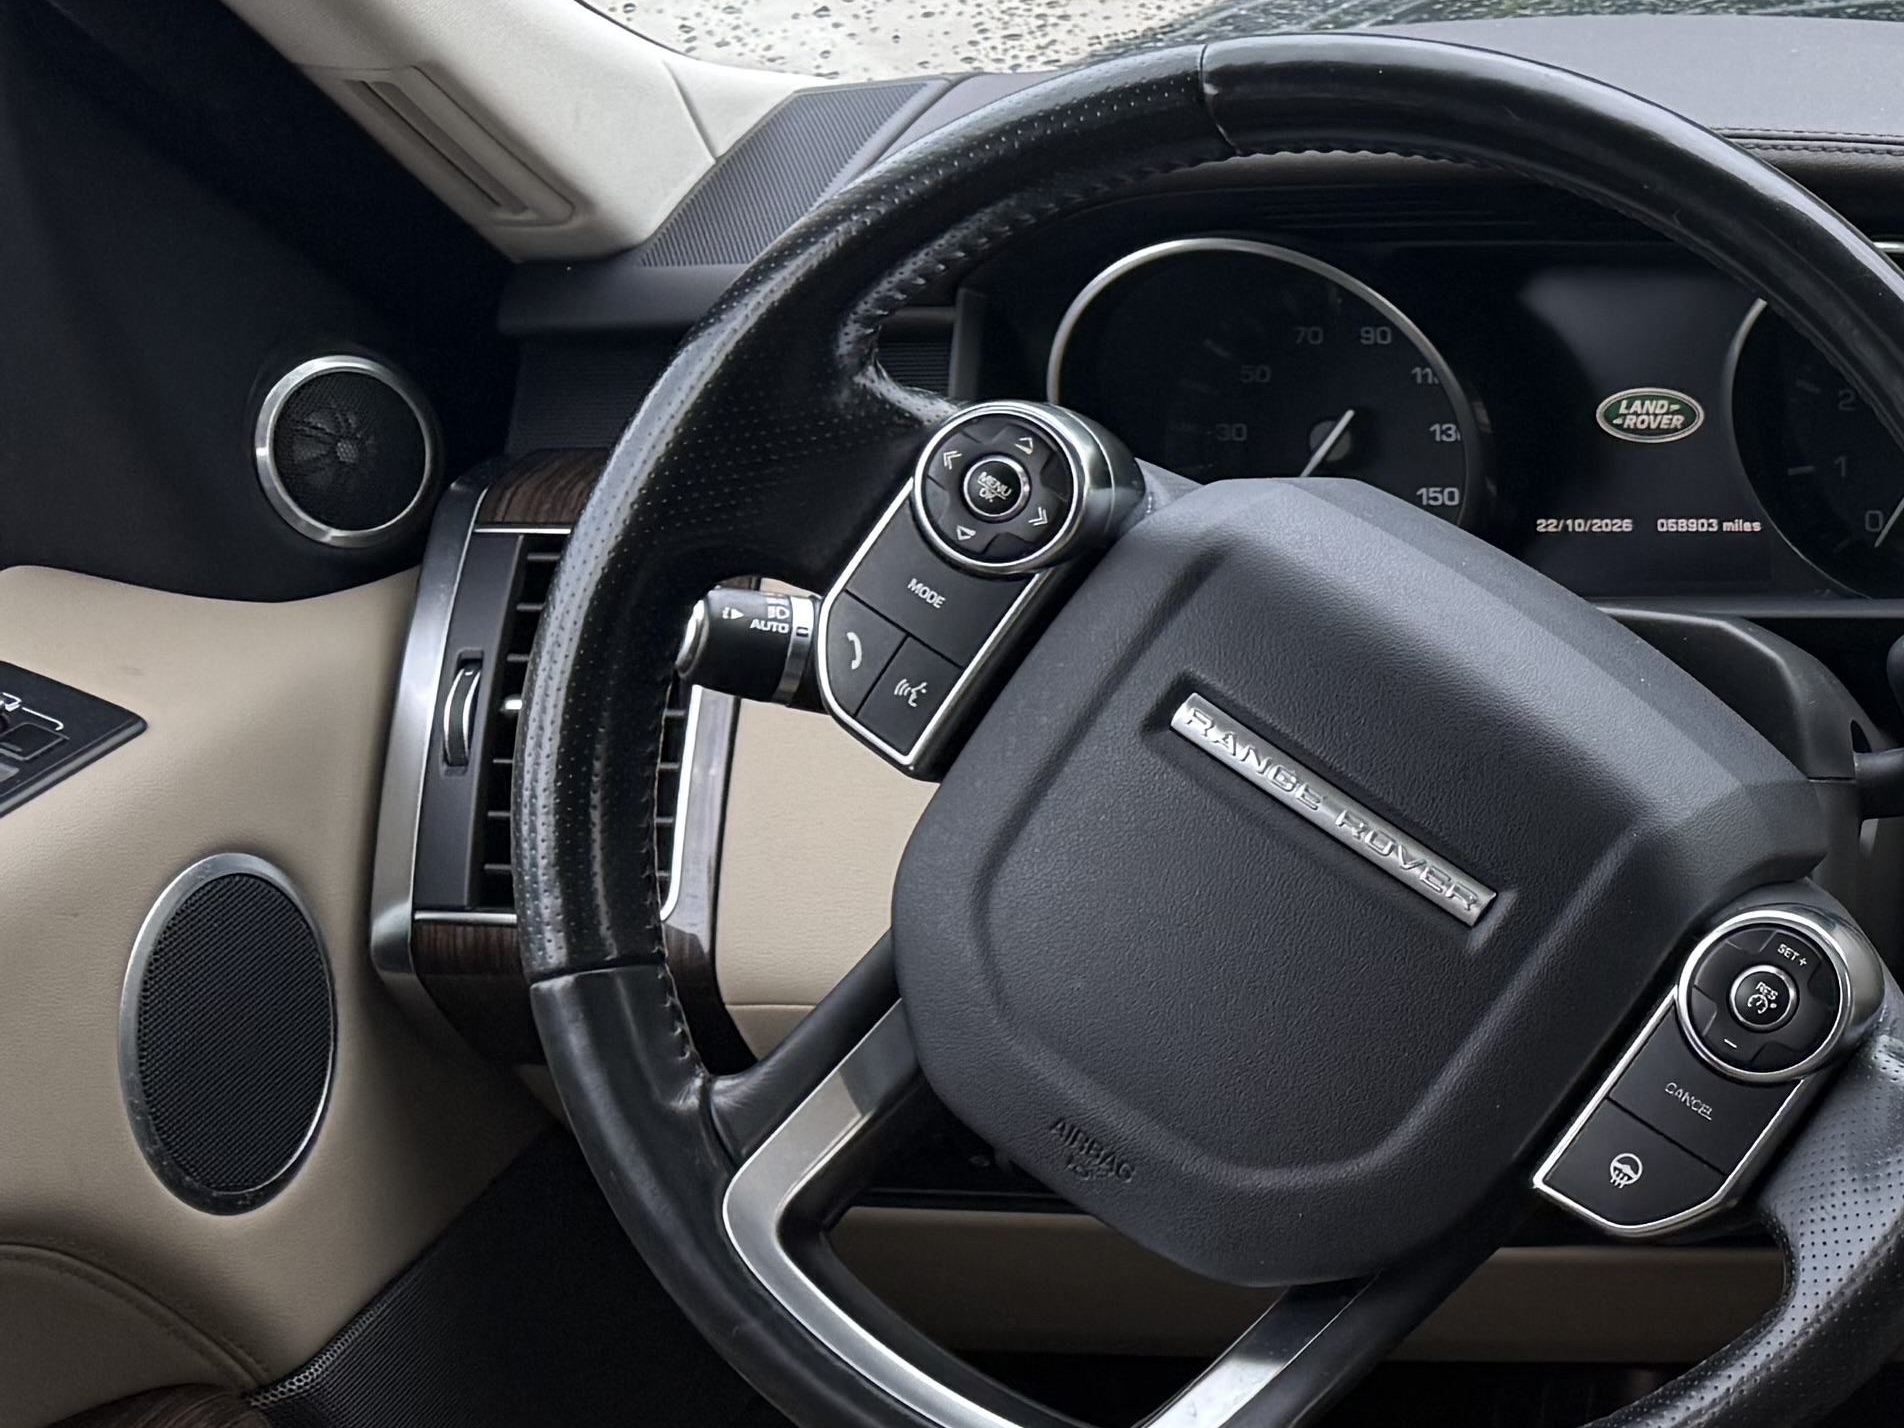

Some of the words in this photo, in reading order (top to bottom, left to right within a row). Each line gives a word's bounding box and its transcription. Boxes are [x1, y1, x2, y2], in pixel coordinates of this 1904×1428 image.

[1295, 327, 1323, 344] 70
[1360, 327, 1391, 345] 90
[1240, 366, 1270, 383] 50
[1411, 367, 1439, 384] 11
[1619, 400, 1668, 414] LAND
[1838, 391, 1855, 410] 2
[1624, 415, 1684, 429] ROVER
[1215, 424, 1247, 441] 30
[1430, 424, 1460, 441] 13
[1833, 456, 1846, 477] 1
[978, 472, 1012, 497] MENU
[1416, 487, 1459, 506] 150
[1536, 519, 1633, 532] 22/10/2026
[1723, 519, 1761, 532] miles
[1864, 510, 1884, 532] 0
[907, 578, 946, 608] MODE
[750, 619, 789, 634] AUTO
[1187, 707, 1325, 811] RANGE
[1335, 810, 1478, 912] ROVER
[1755, 981, 1778, 1001] RES
[1664, 1082, 1713, 1121] CANCEL
[1049, 1118, 1135, 1184] AIRBAG
